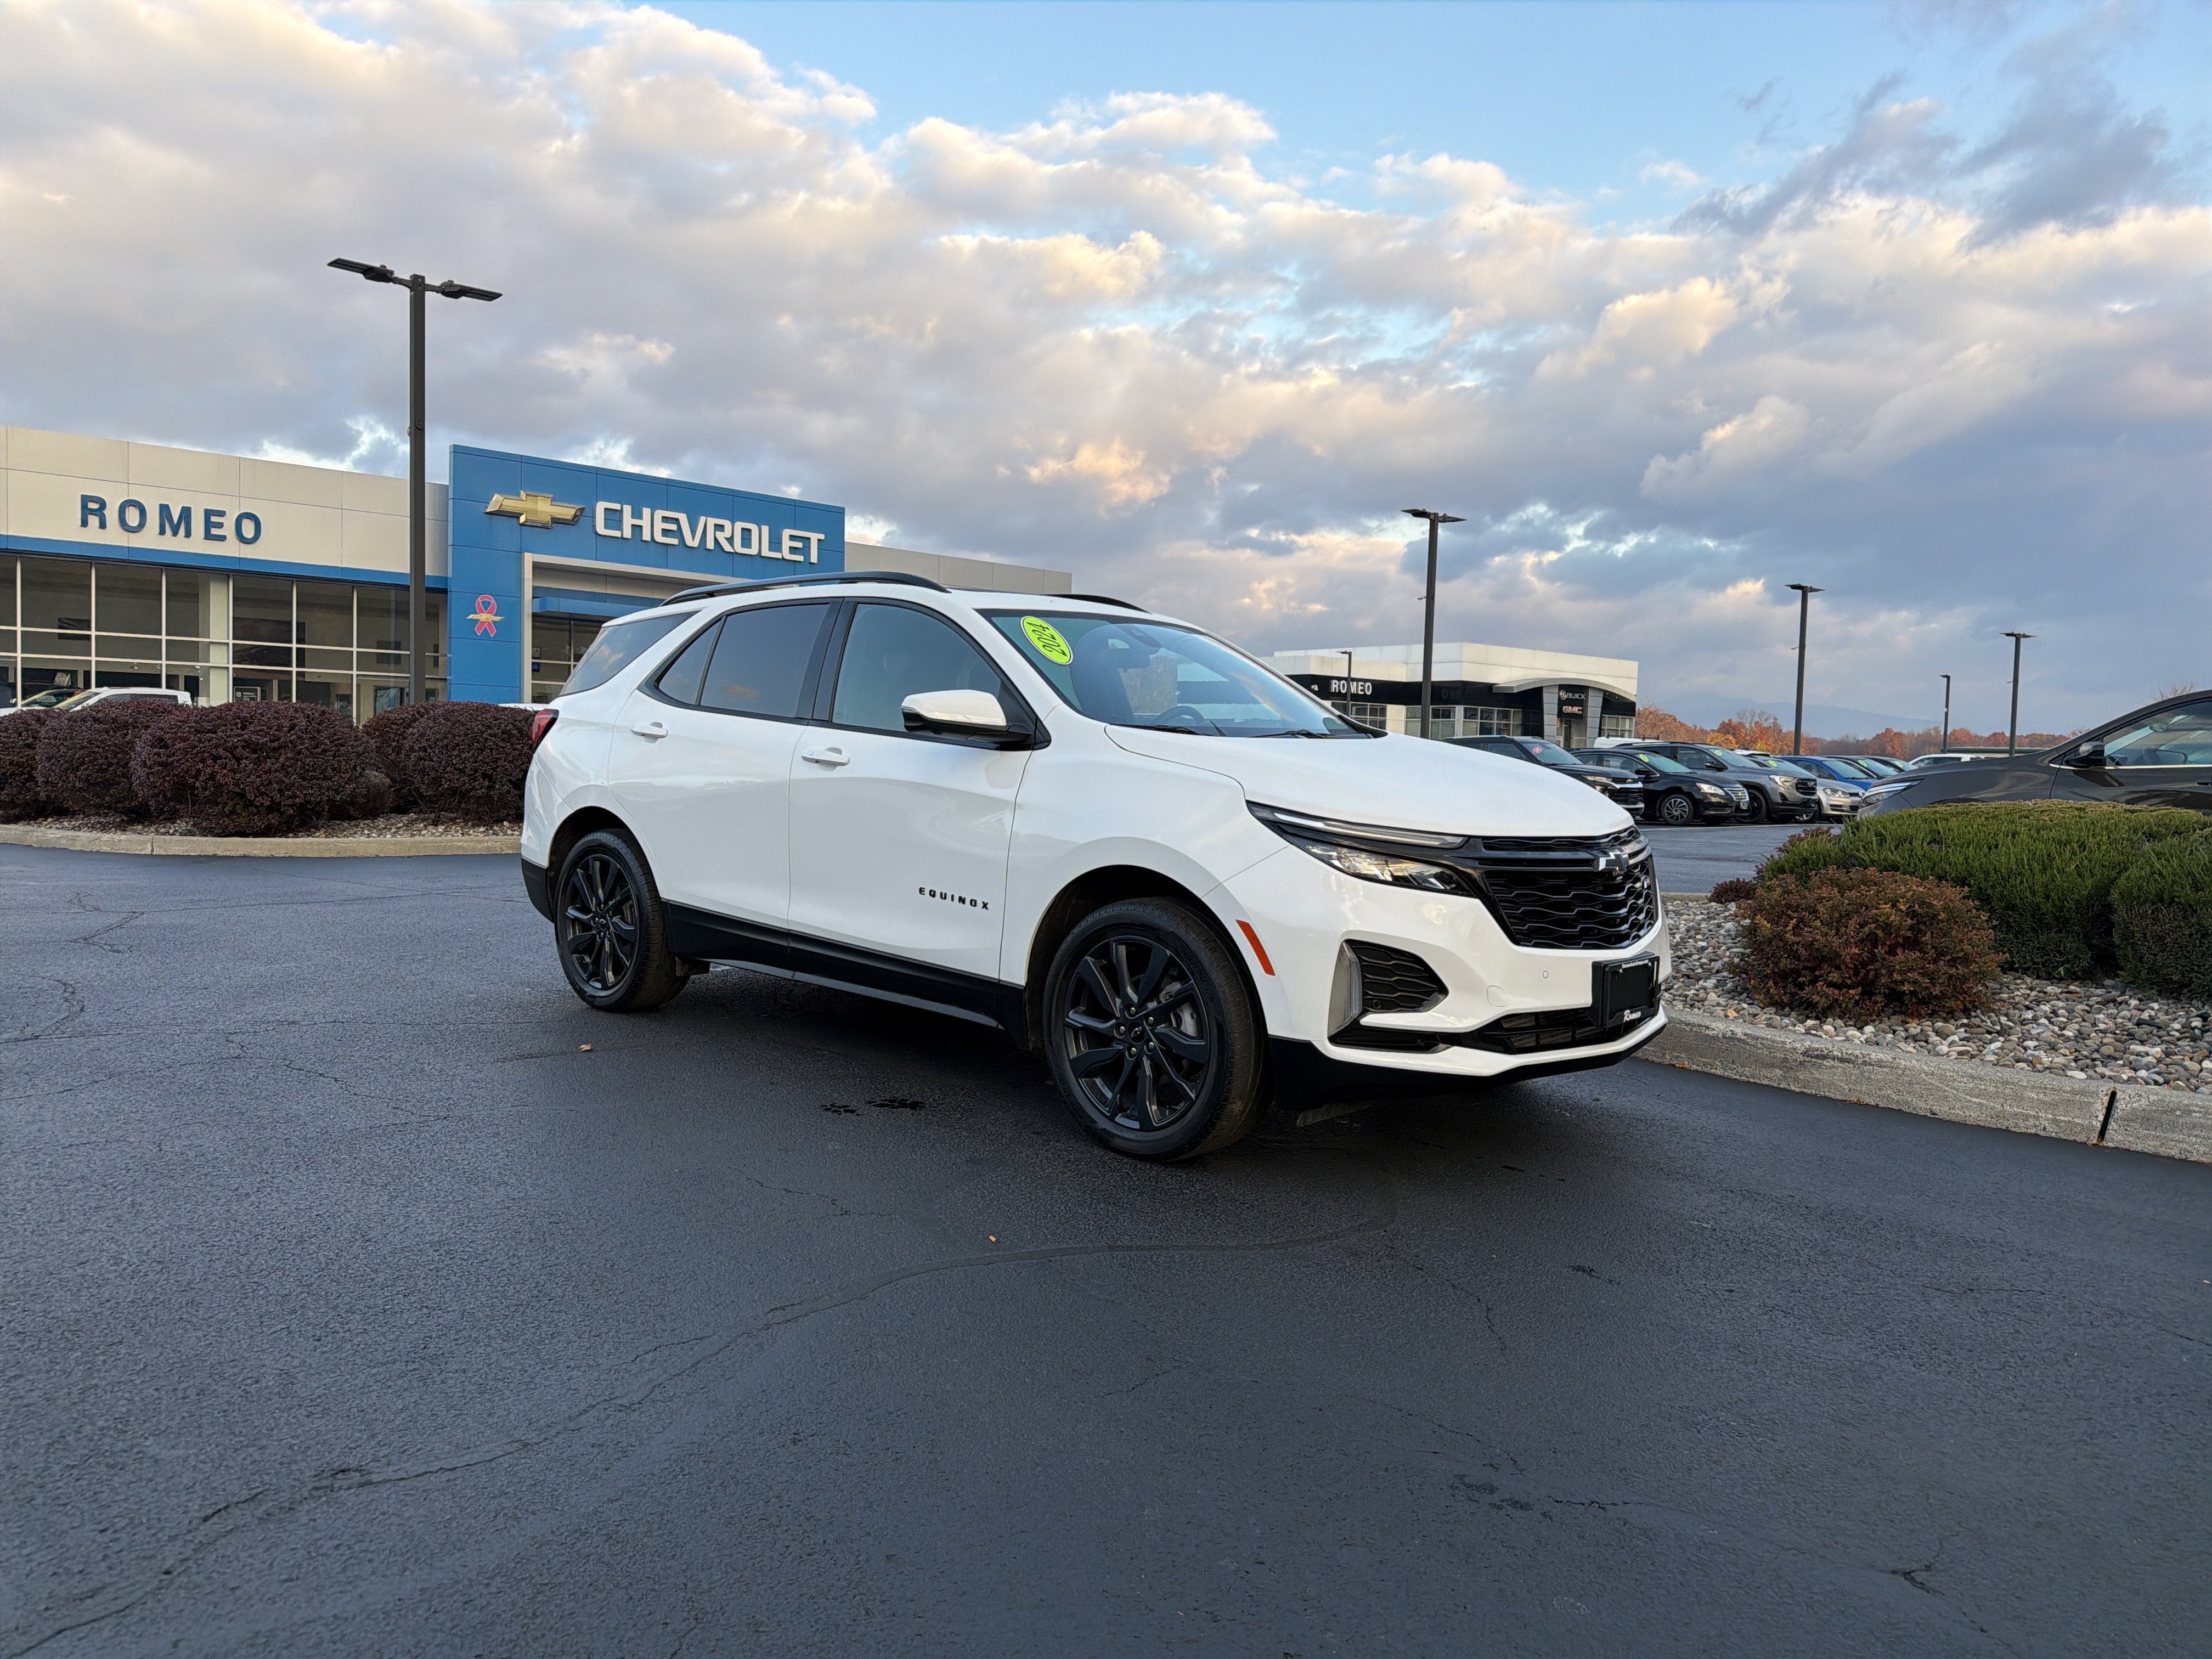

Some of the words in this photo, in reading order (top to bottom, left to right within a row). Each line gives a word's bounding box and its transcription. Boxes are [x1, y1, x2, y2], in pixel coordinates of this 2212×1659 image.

[80, 494, 262, 544] ROMEO
[595, 501, 825, 563] CHEVROLET
[1025, 622, 1068, 657] 2024
[1330, 680, 1372, 695] ROMEO
[1562, 706, 1583, 714] GMC
[918, 887, 989, 910] EQUINOX
[1623, 1009, 1641, 1023] Romeo
